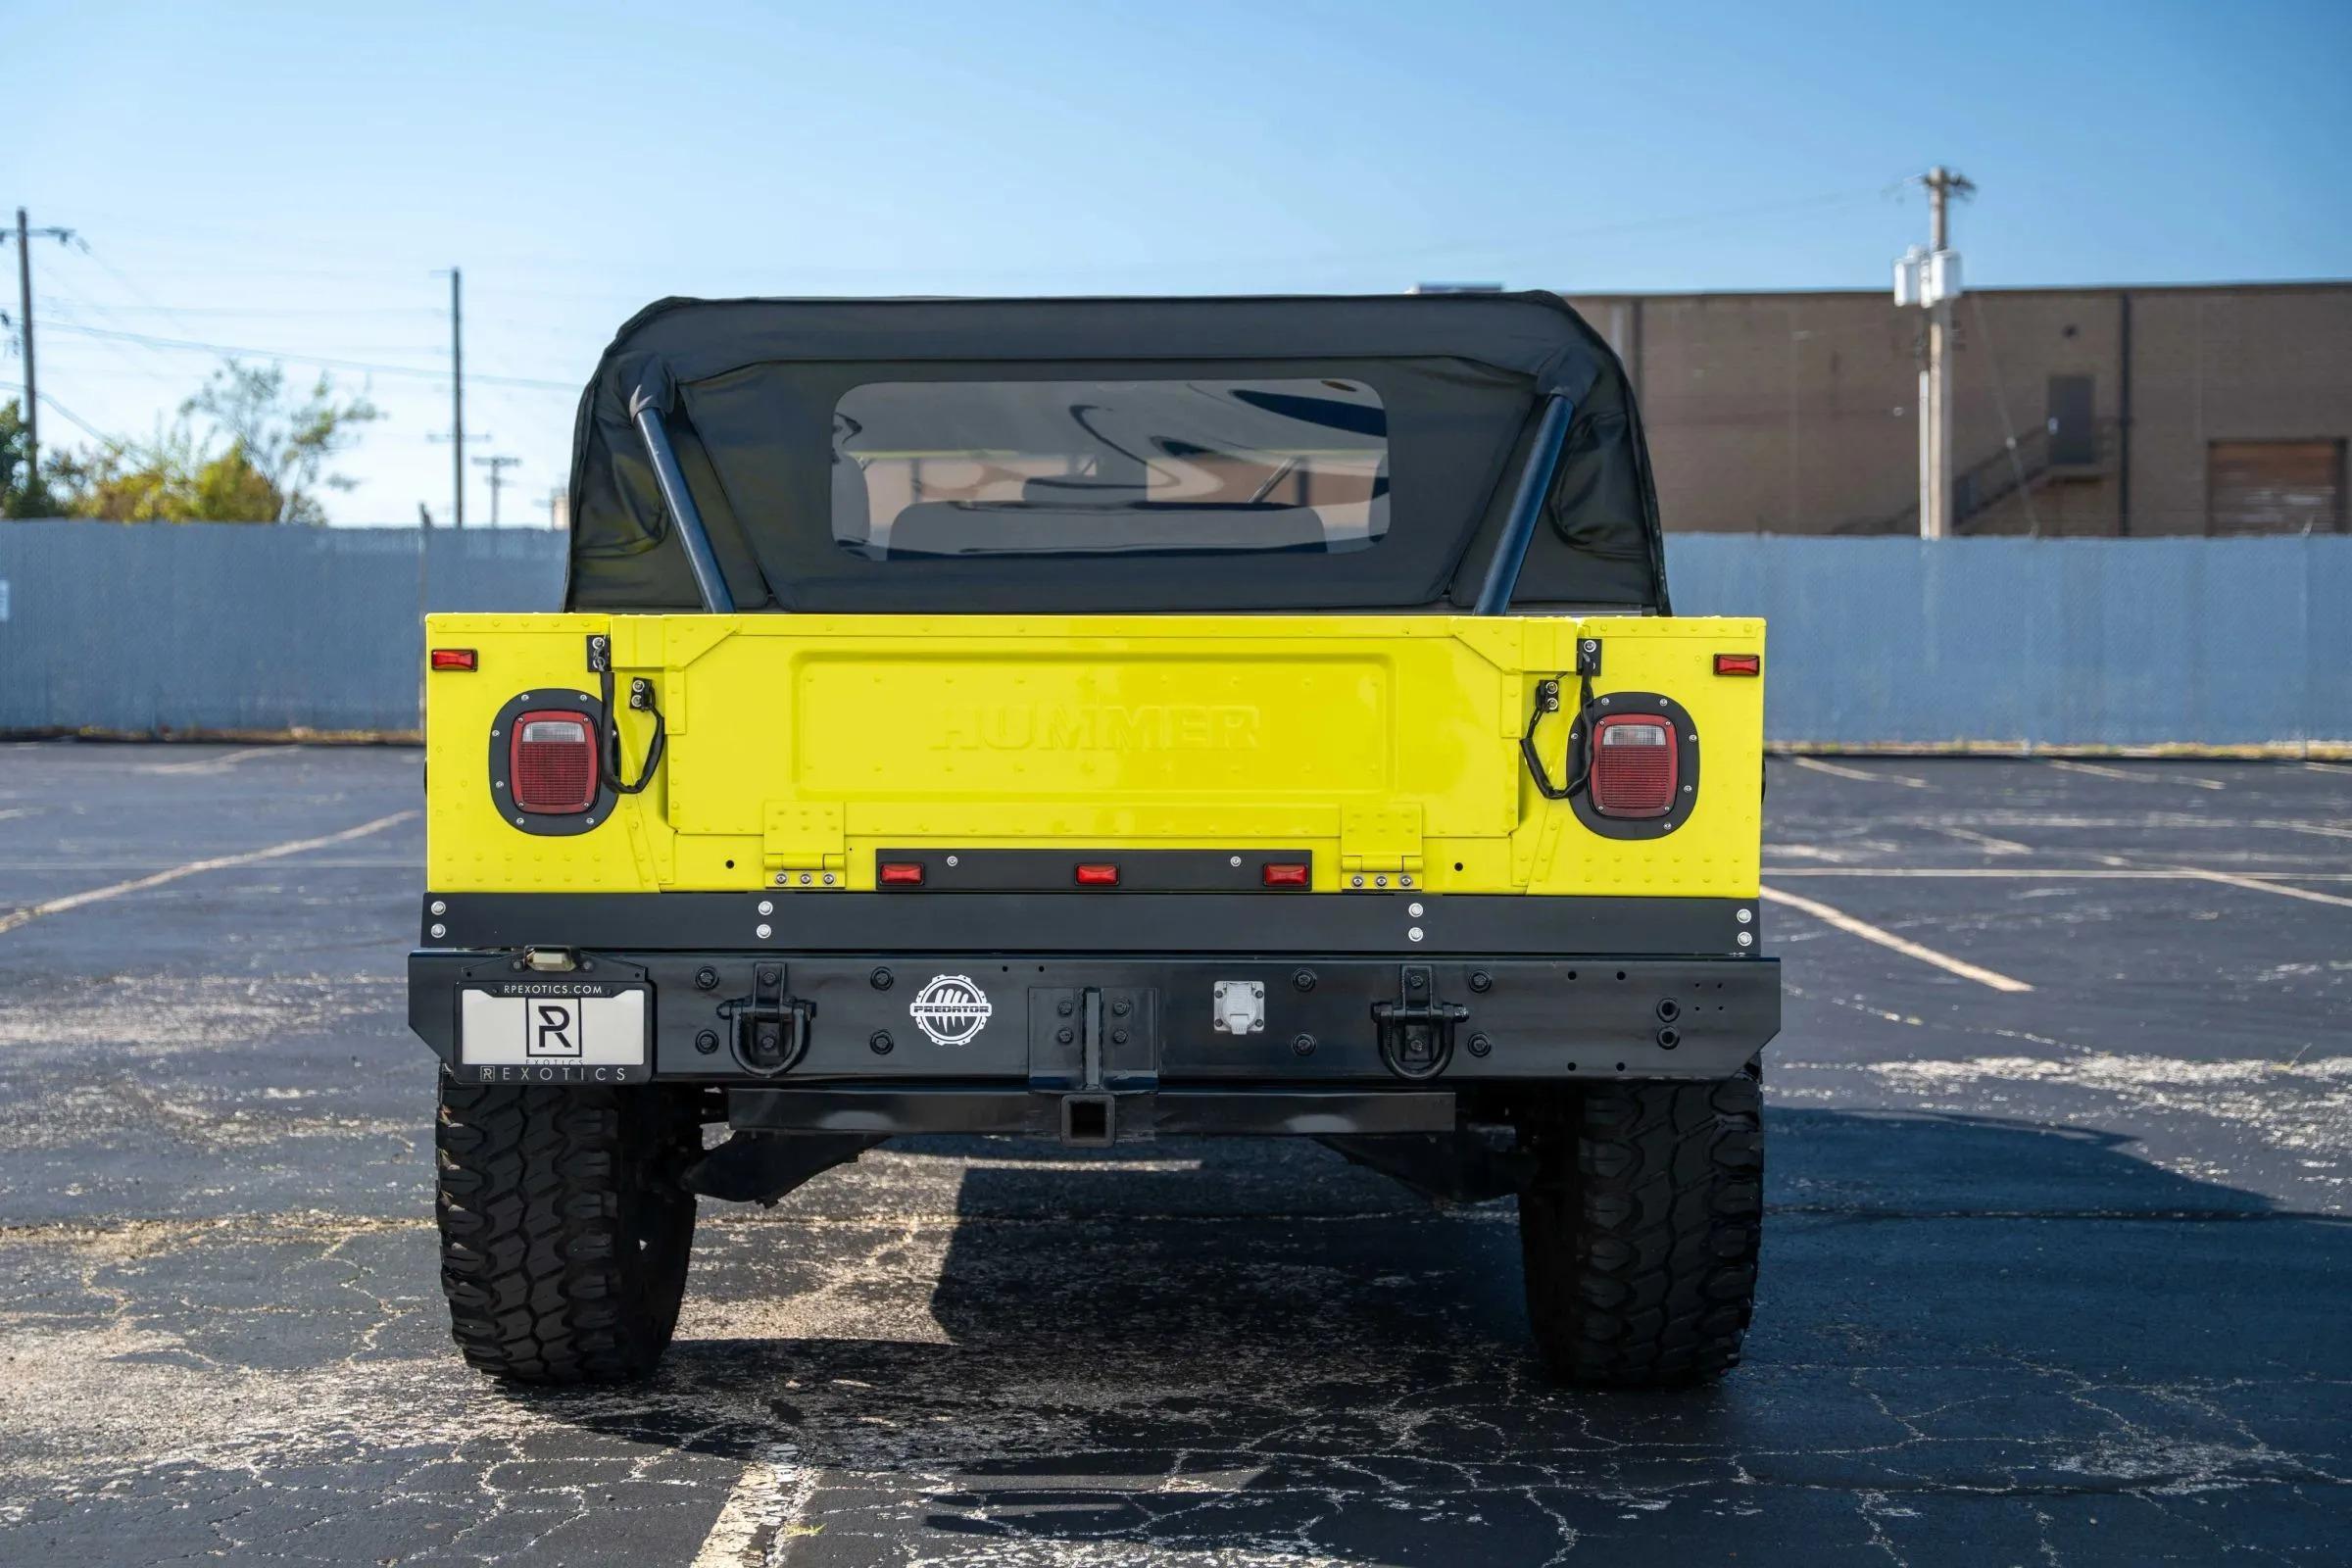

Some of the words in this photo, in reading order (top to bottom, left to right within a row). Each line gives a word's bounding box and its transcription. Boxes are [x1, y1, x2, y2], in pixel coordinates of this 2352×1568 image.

[930, 705, 1260, 751] HUMMER
[504, 984, 602, 994] RPEXOTICS.COM
[503, 1067, 625, 1081] EXOTICS
